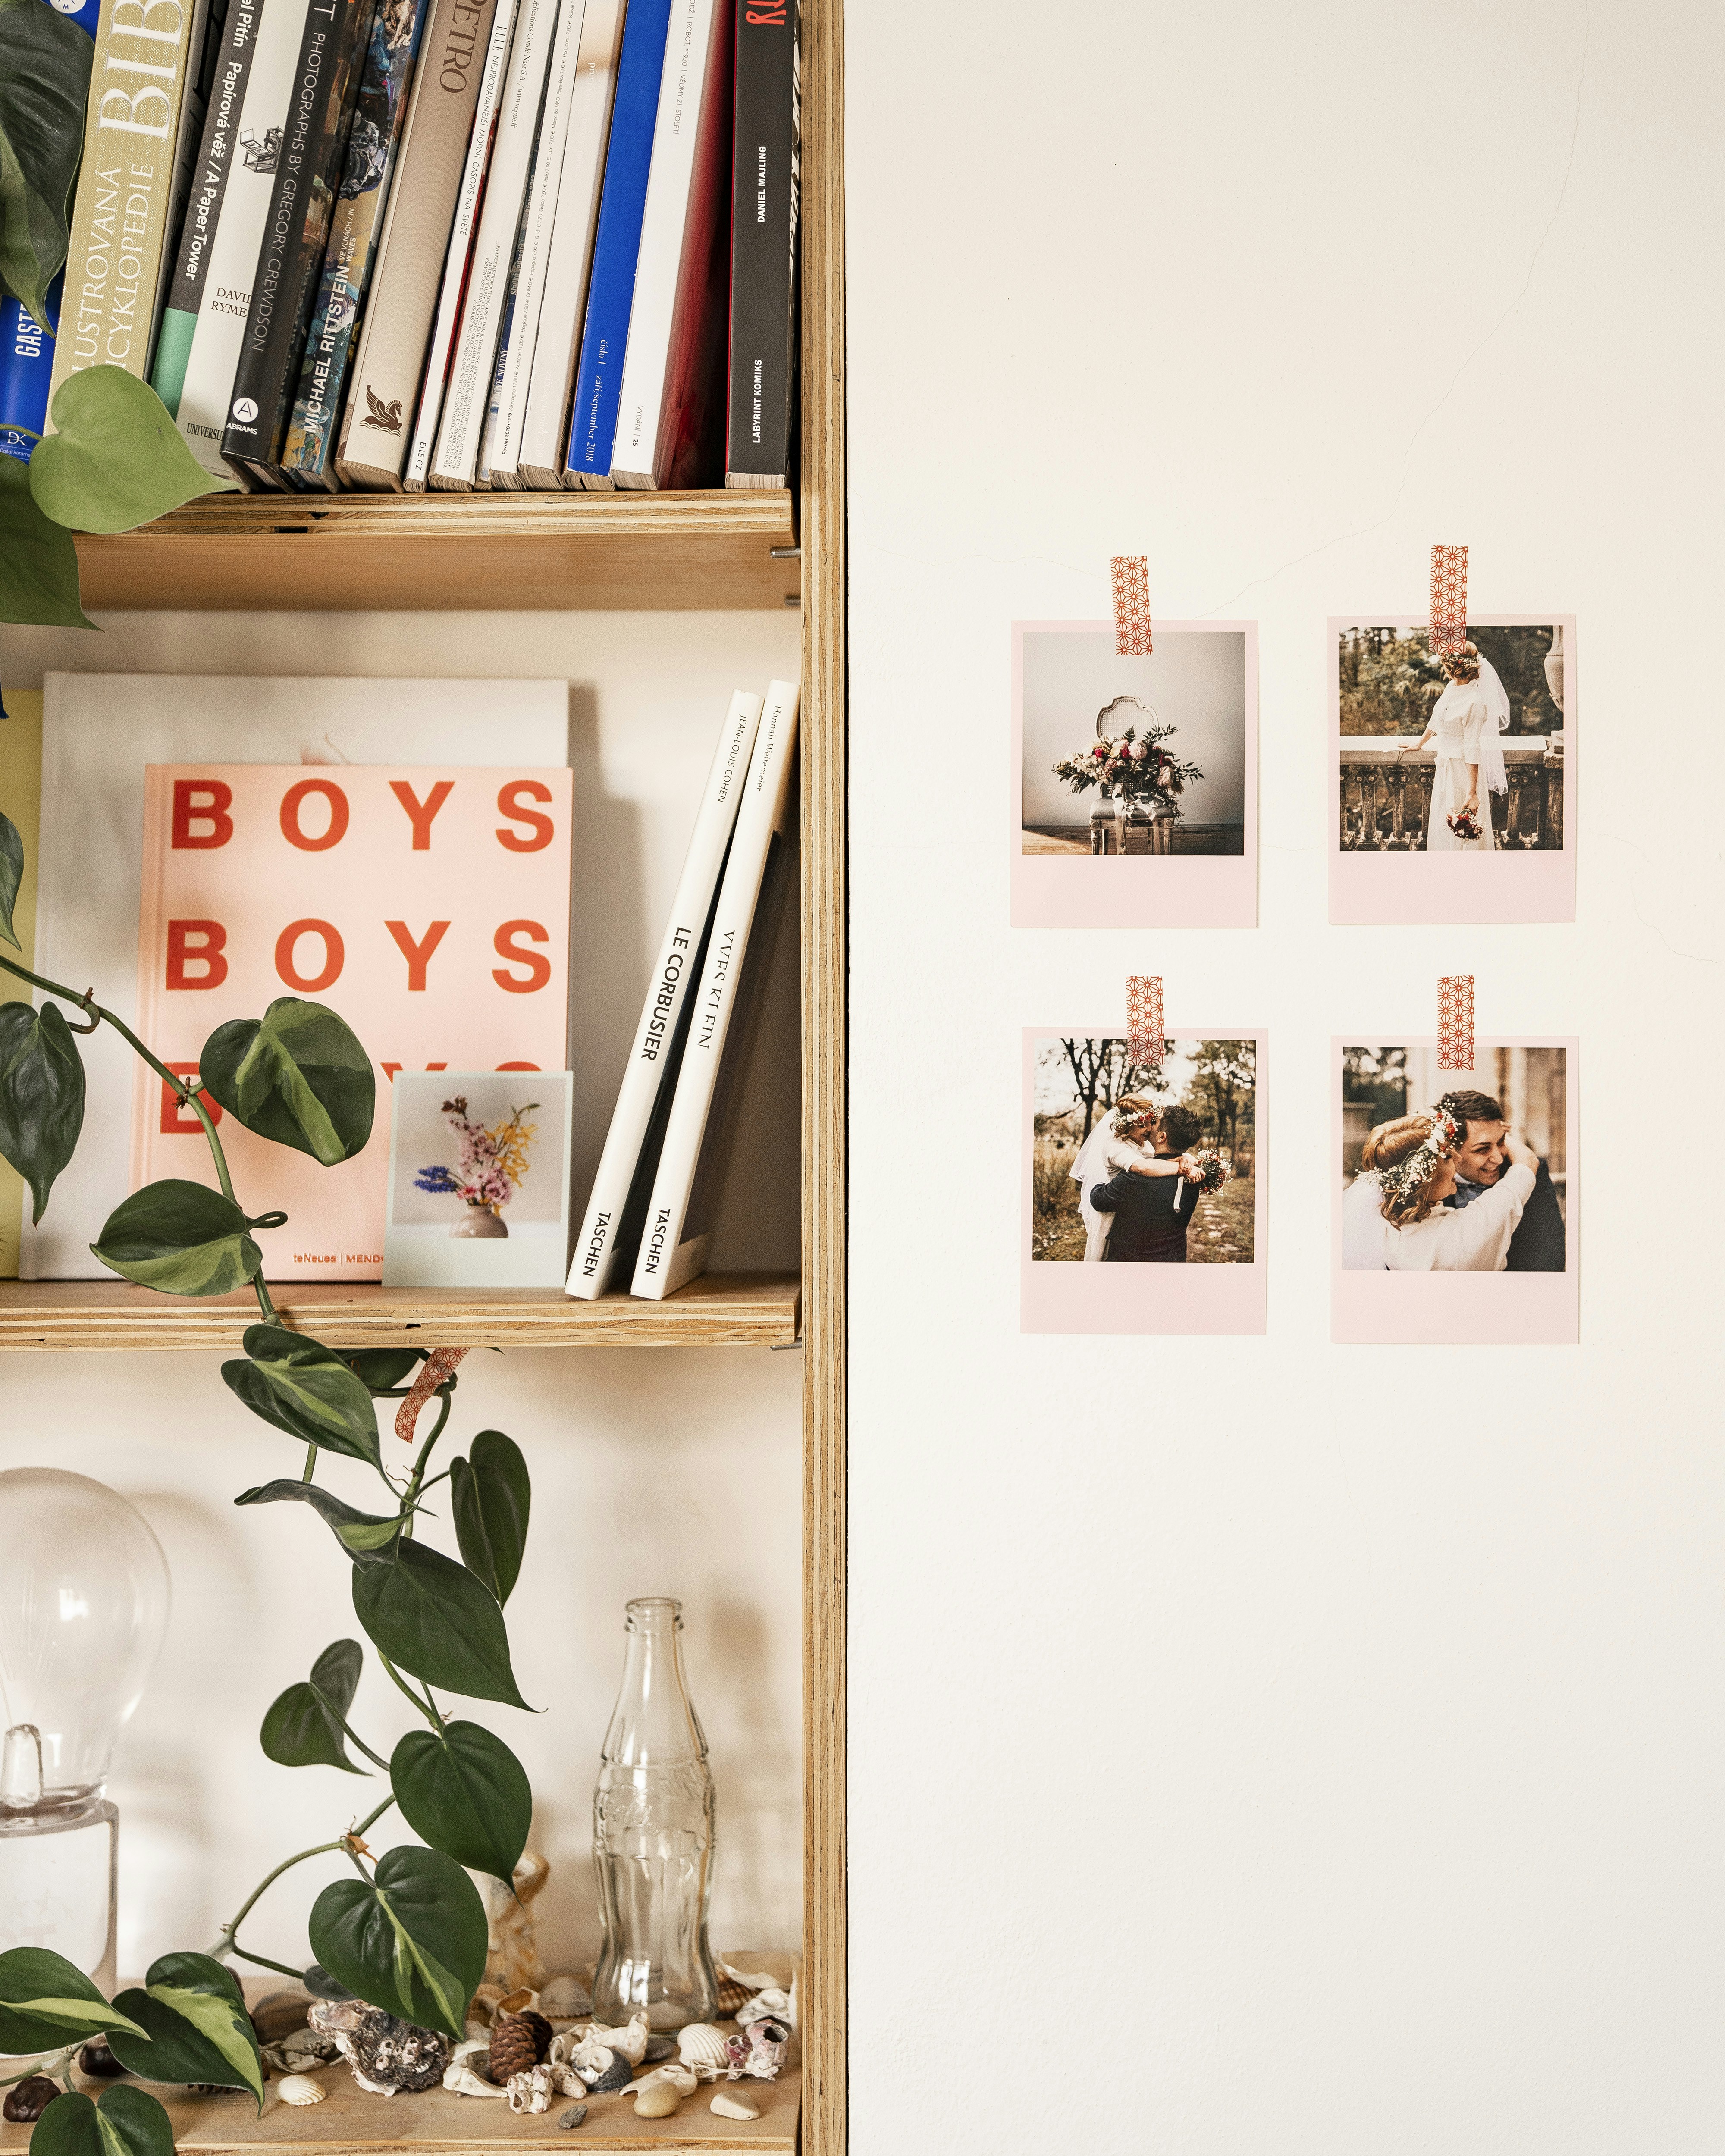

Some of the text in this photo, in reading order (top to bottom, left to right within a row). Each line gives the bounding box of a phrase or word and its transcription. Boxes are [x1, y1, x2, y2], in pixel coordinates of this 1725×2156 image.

[232, 12, 254, 49] Pitín
[524, 33, 533, 53] Condé
[683, 22, 693, 46] ROBOT,
[521, 54, 530, 69] Nast
[216, 61, 243, 128] Papírová
[677, 75, 687, 98] VĚDMY
[511, 88, 522, 128] www.vogue.fr
[673, 109, 681, 135] STOLETÍ
[210, 130, 229, 160] věž
[459, 26, 507, 235] ELLE NEJPRODÁVANĚJŠÍ MÓDNÍ ČASOPIS NA SVĚTĚ
[205, 170, 220, 183] A
[251, 32, 326, 351] PHOTOGRAPHS BY GREGORY CREWDSON
[757, 146, 767, 223] DANIEL MAJLING
[195, 187, 217, 232] Paper
[339, 208, 355, 260] VE VLNÁCH IN
[345, 236, 358, 263] WAVES
[185, 231, 209, 282] Tower
[475, 292, 483, 318] FINLANDE
[478, 301, 486, 326] BELGIQUE
[15, 303, 43, 357] GAST
[301, 264, 351, 433] MICHAEL RITTSTEIN
[497, 350, 508, 377] NOVINY
[599, 339, 608, 358] číslo
[456, 372, 464, 396] PORTUGAL
[461, 373, 472, 419] GRANDE-BRETAGNE
[752, 359, 762, 444] LABYRINT KOMIKS
[450, 397, 460, 430] CONTINENTAL
[588, 375, 602, 440] září/september
[634, 406, 643, 432] VYDÁNÍ
[7, 432, 27, 446] DK
[226, 422, 258, 435] ABRAMS
[450, 422, 460, 455] LUXEMBOURG
[458, 426, 467, 455] ALLEMAGNE
[415, 442, 427, 470] ELLE.CZ
[585, 442, 596, 461] 2018
[717, 714, 748, 803] JEAN-LOUIS COHEN
[756, 706, 782, 792] Hannah Weitemeier
[172, 778, 554, 853] BOYS
[165, 918, 551, 993] BOYS
[714, 930, 735, 981] YVES
[641, 927, 692, 1061] LE CORBUSIER
[293, 1253, 383, 1263] teNeues MEND
[582, 1213, 612, 1277] TASCHEN
[645, 1208, 671, 1274] TASCHEN
